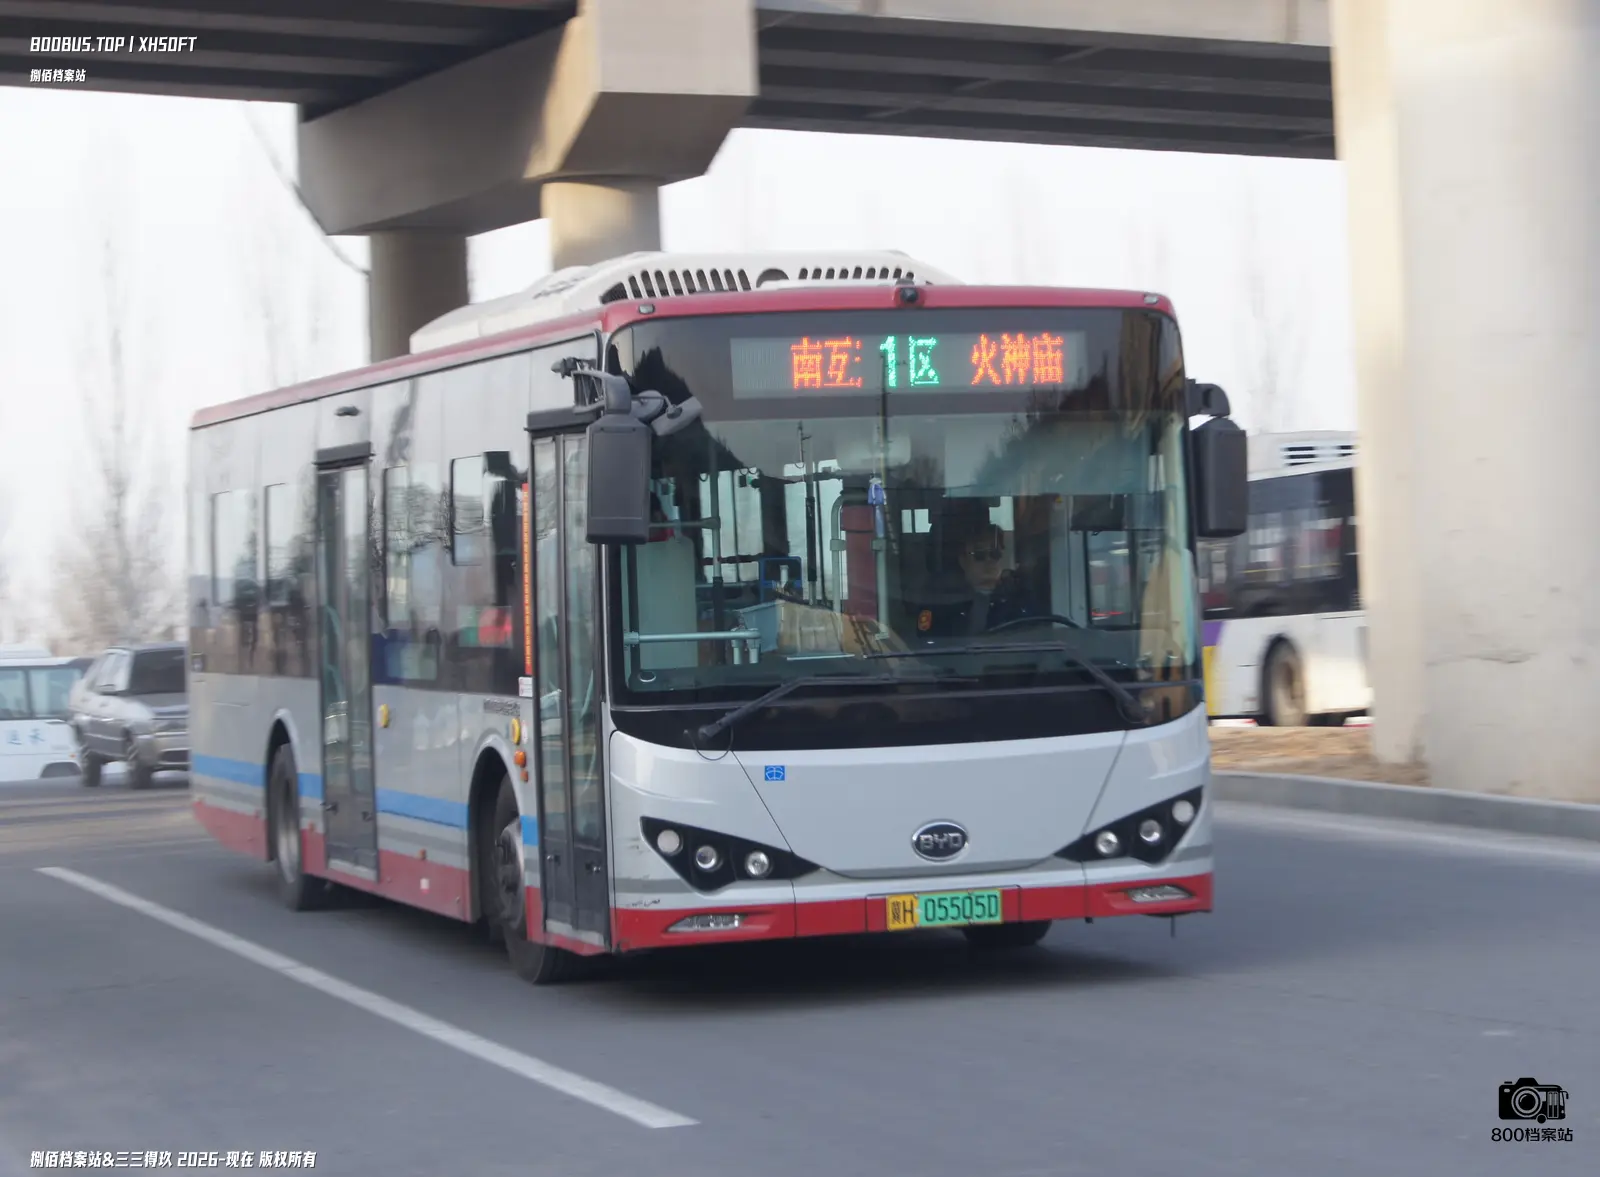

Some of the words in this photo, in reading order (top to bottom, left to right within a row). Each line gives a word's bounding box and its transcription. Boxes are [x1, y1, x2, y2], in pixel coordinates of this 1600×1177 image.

[791, 336, 863, 389] 南互
[971, 332, 1065, 385] 火神庙
[919, 831, 963, 851] BYD
